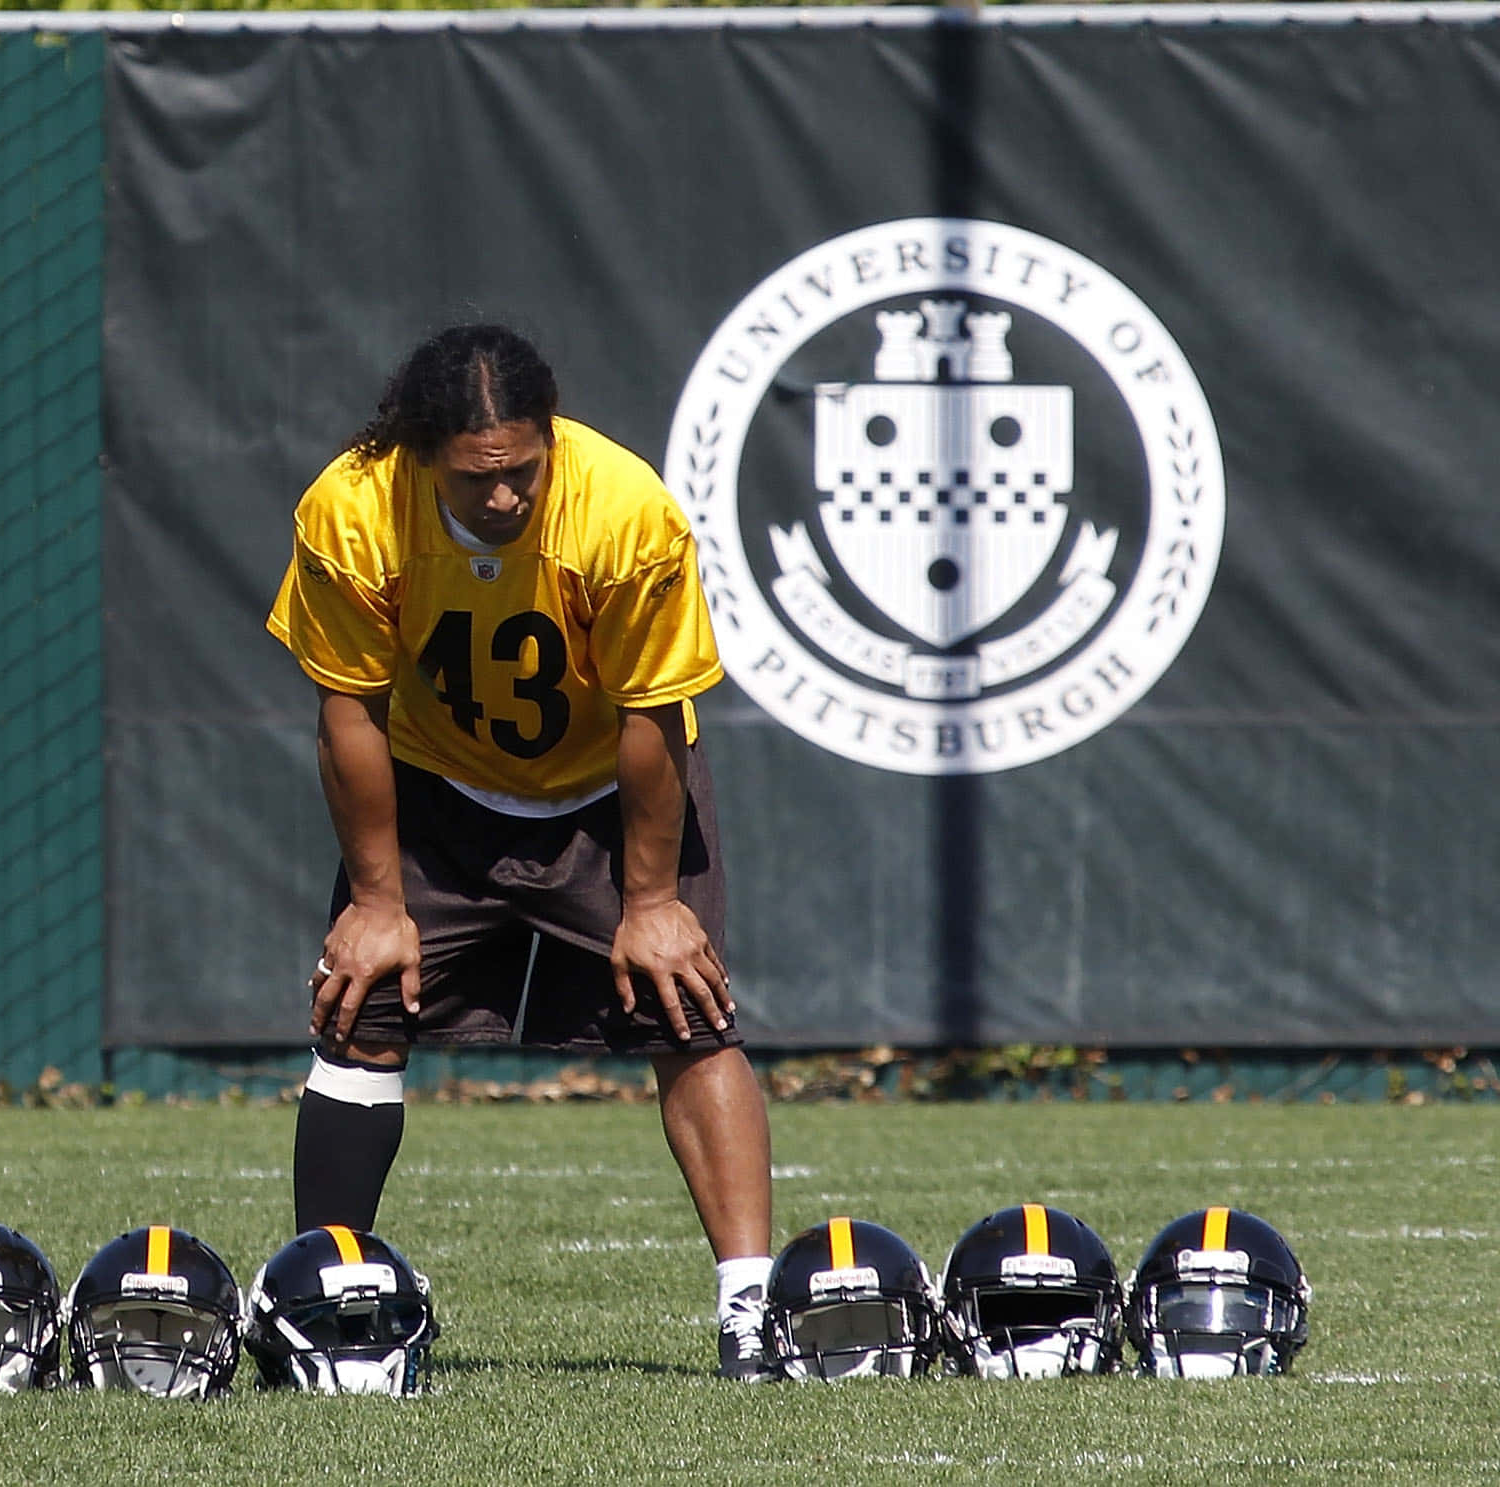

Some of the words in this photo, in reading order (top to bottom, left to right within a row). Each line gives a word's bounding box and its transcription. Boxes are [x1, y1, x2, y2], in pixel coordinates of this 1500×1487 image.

[717, 236, 1090, 386] UNIVERSITY
[1106, 320, 1172, 388] OF
[417, 609, 570, 761] 43
[750, 646, 1134, 758] PITTSBURGH
